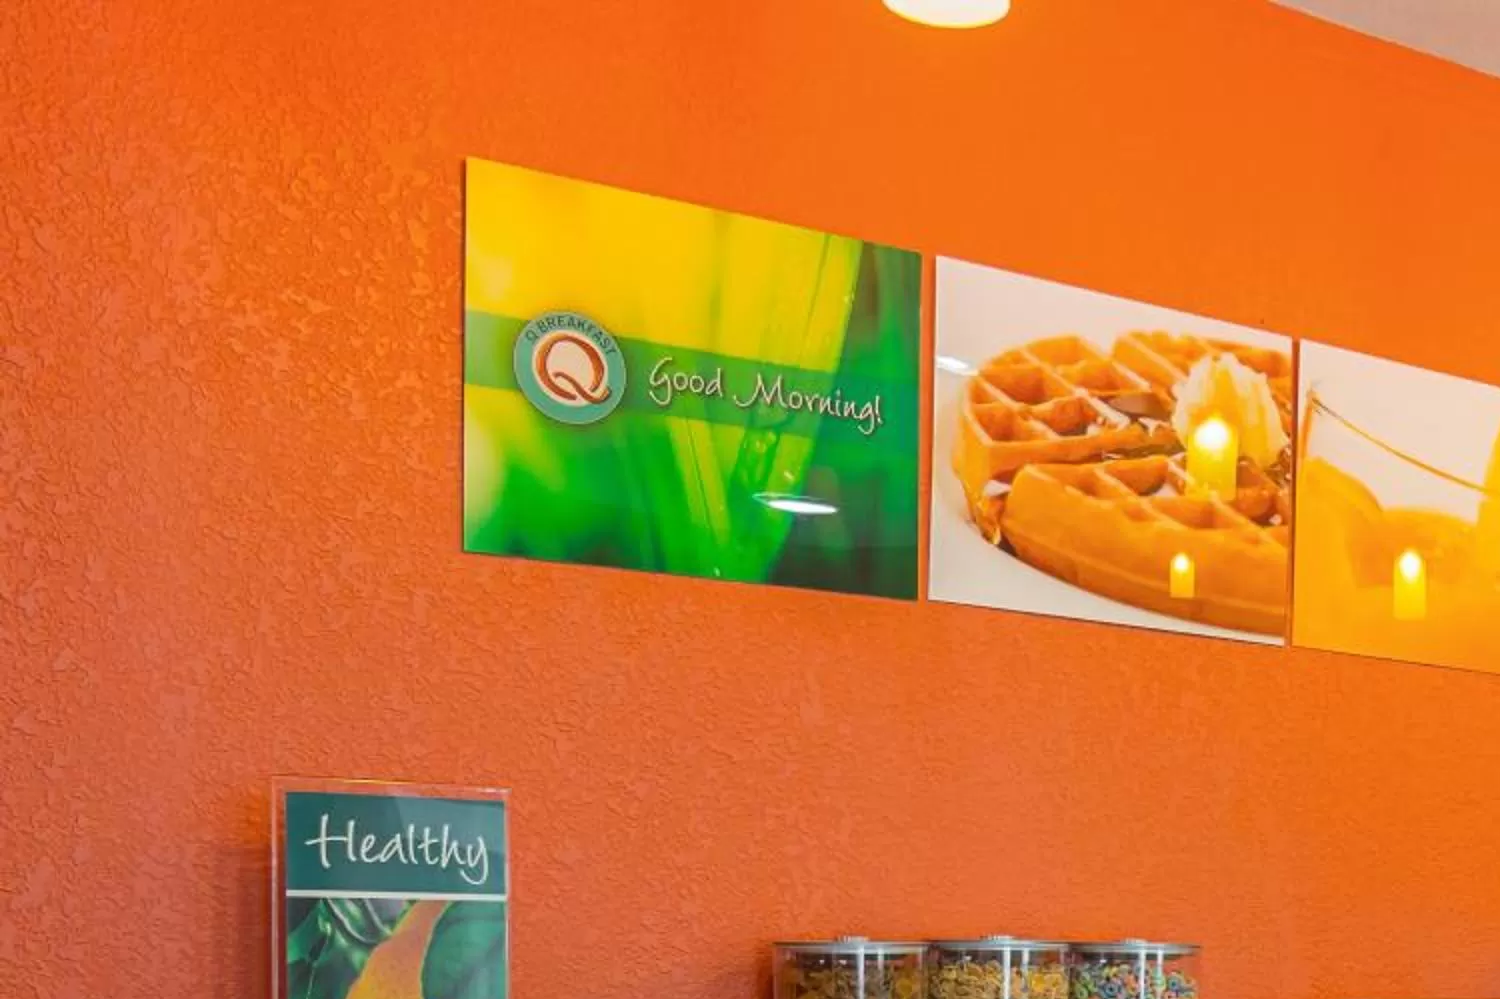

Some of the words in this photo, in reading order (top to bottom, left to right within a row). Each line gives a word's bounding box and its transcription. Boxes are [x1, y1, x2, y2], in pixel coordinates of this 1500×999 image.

[535, 331, 613, 405] Q
[538, 315, 617, 355] BREAKFAST
[648, 356, 724, 406] Good
[733, 372, 884, 435] Morning!
[304, 813, 489, 886] Healthy
